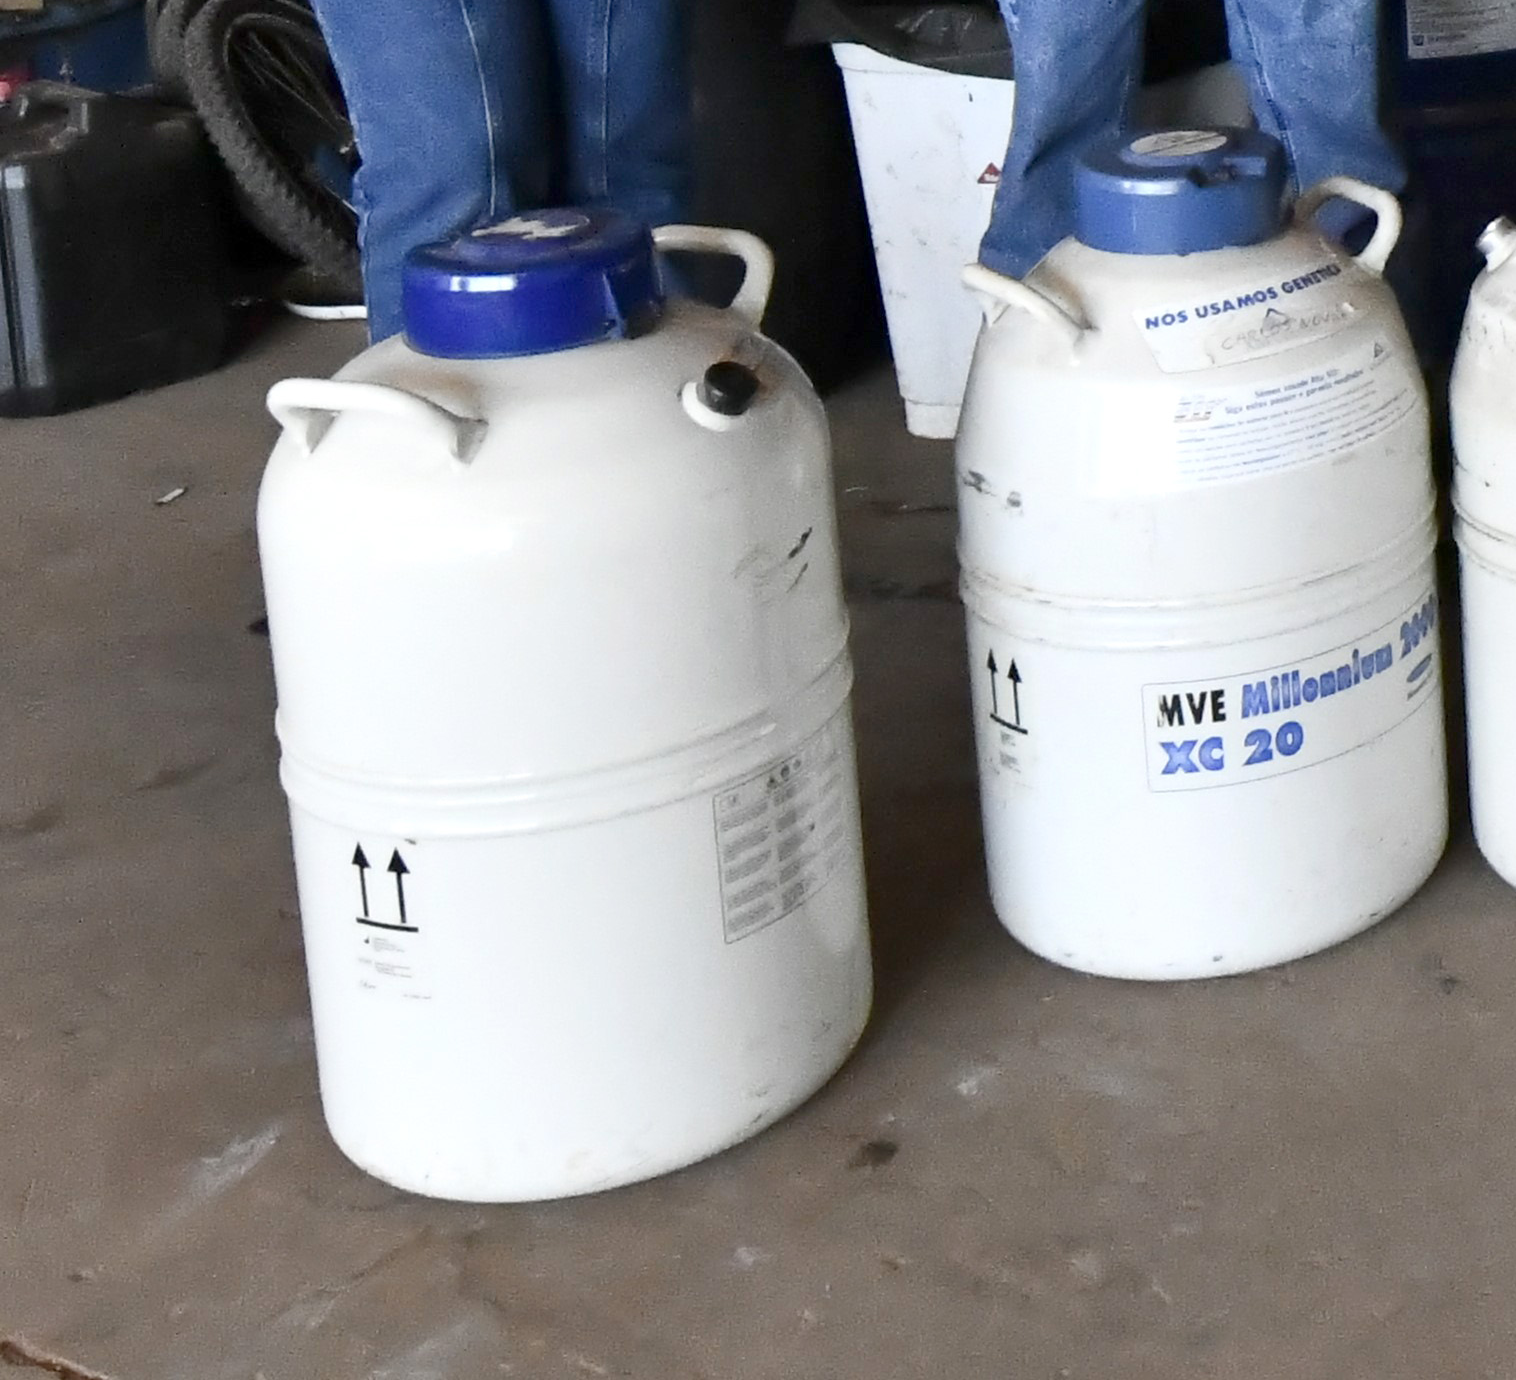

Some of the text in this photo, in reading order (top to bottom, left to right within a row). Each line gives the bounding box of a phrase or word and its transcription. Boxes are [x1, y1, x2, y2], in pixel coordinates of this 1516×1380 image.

[1145, 310, 1188, 329] NOS
[1195, 287, 1278, 318] USAMOS
[1157, 688, 1226, 728] MVE
[1160, 720, 1304, 775] XC 20
